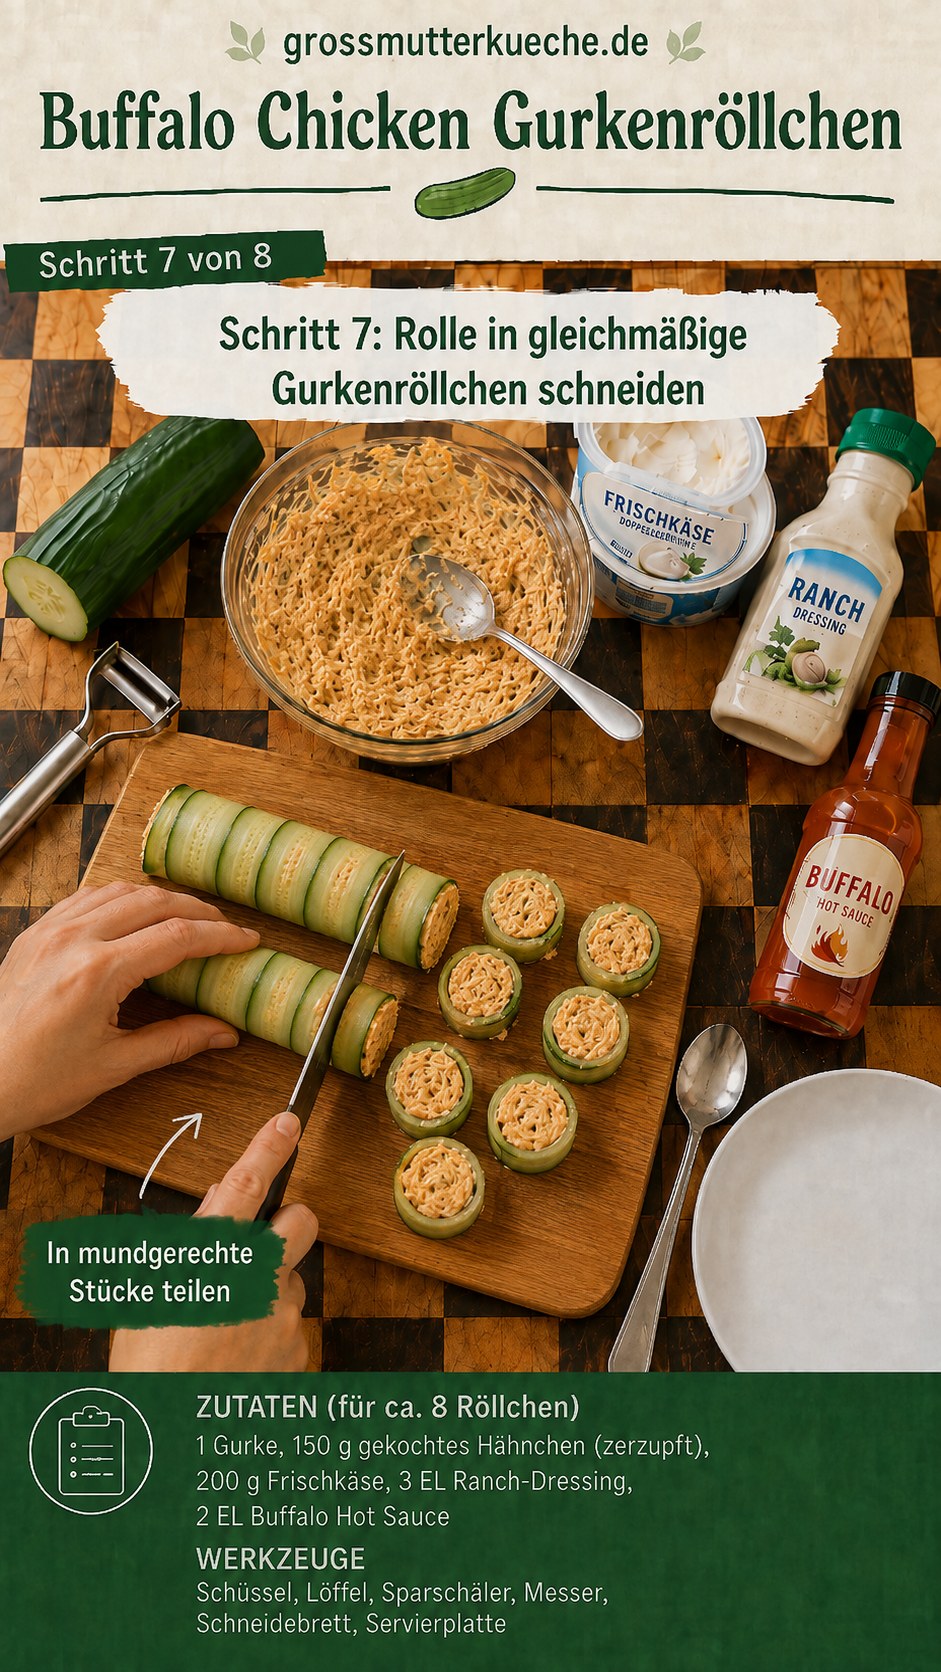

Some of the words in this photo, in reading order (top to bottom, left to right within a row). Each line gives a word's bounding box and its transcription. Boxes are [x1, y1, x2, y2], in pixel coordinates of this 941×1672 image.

[604, 489, 715, 546] FRISCHKÄSE
[787, 576, 866, 623] RANCH
[792, 606, 847, 636] DRESSING
[805, 864, 894, 916] BUFFALO
[816, 896, 840, 914] HOT
[841, 905, 875, 929] SAUCE
